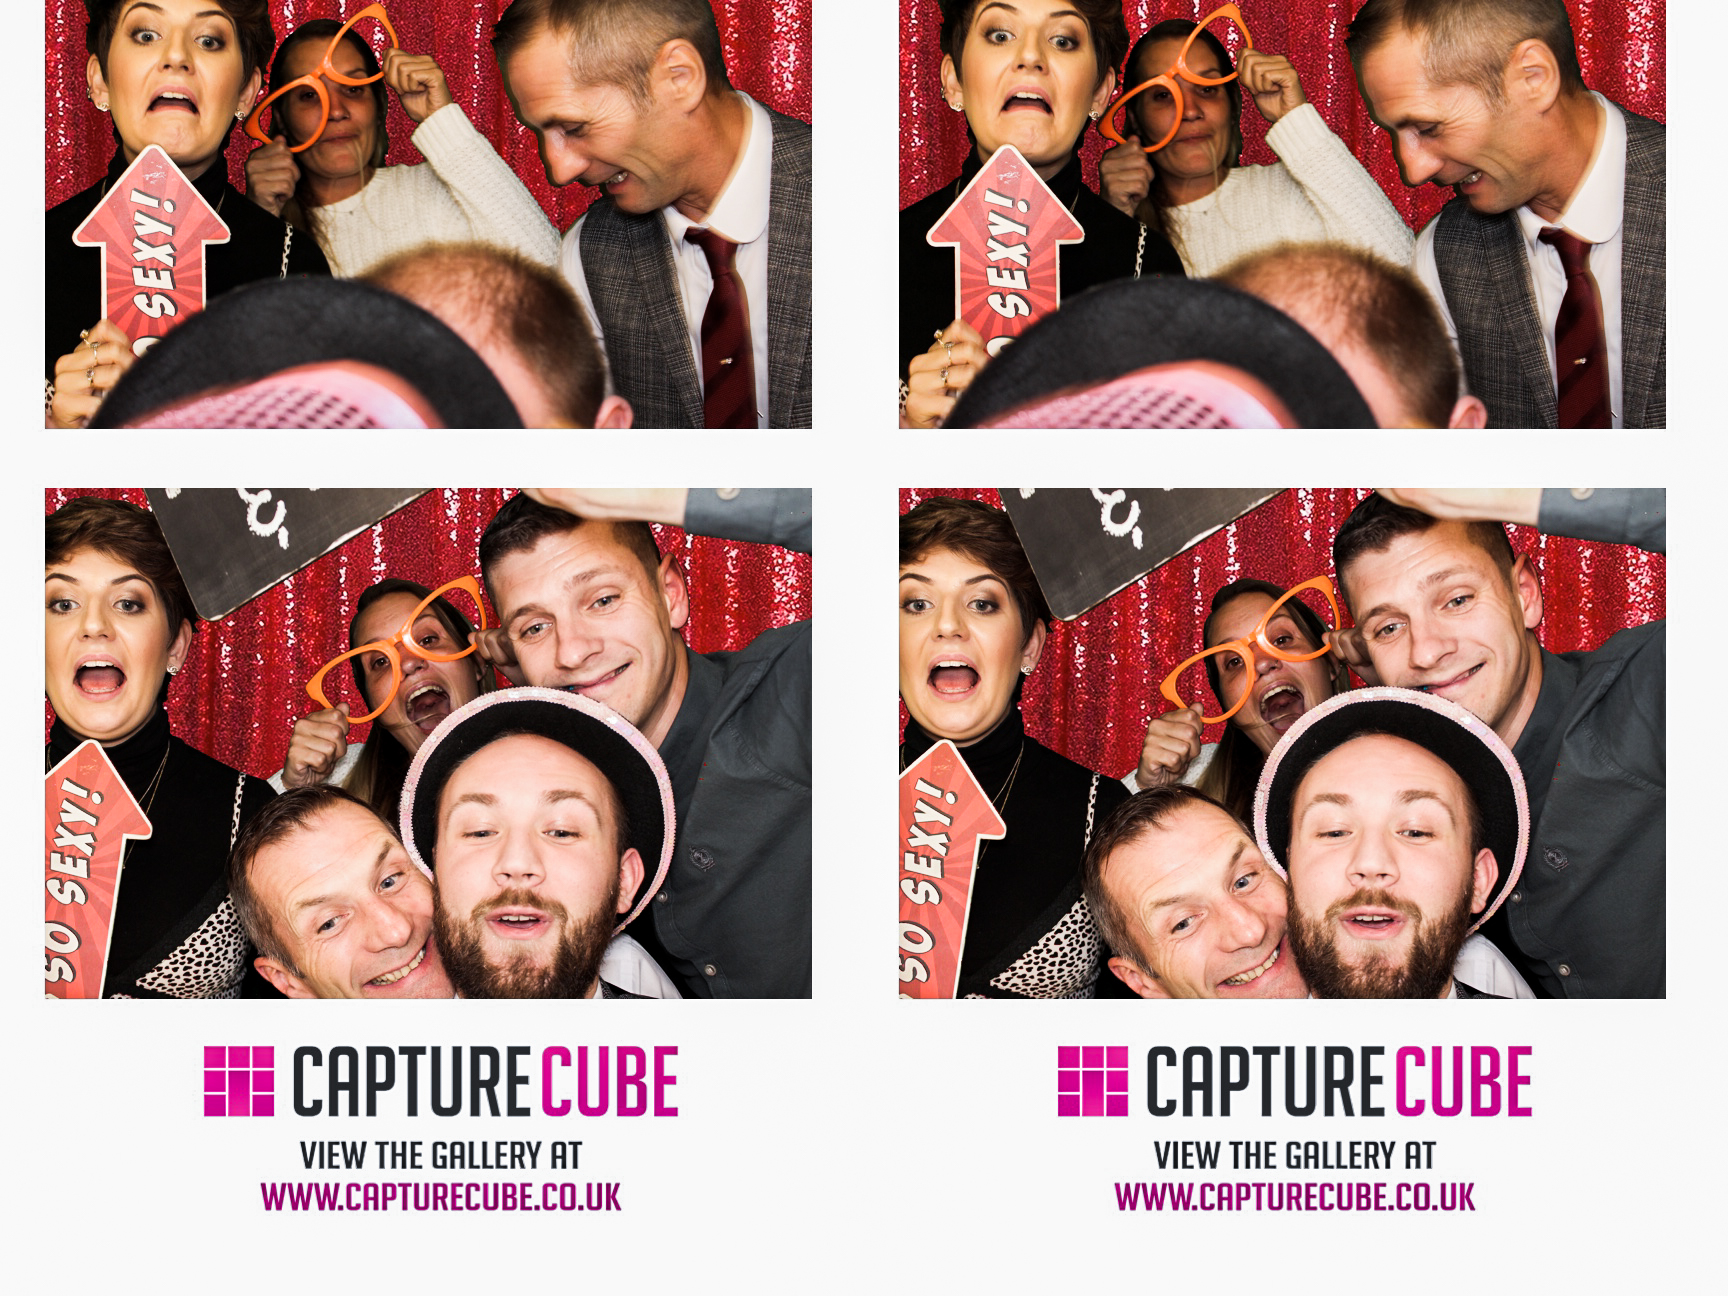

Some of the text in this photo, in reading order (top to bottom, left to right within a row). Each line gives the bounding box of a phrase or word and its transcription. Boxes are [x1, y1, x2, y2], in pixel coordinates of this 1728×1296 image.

[130, 188, 178, 319] SEXY!
[984, 188, 1032, 319] SEXY!
[46, 777, 104, 906] SEXY!
[900, 777, 958, 906] SEXY!
